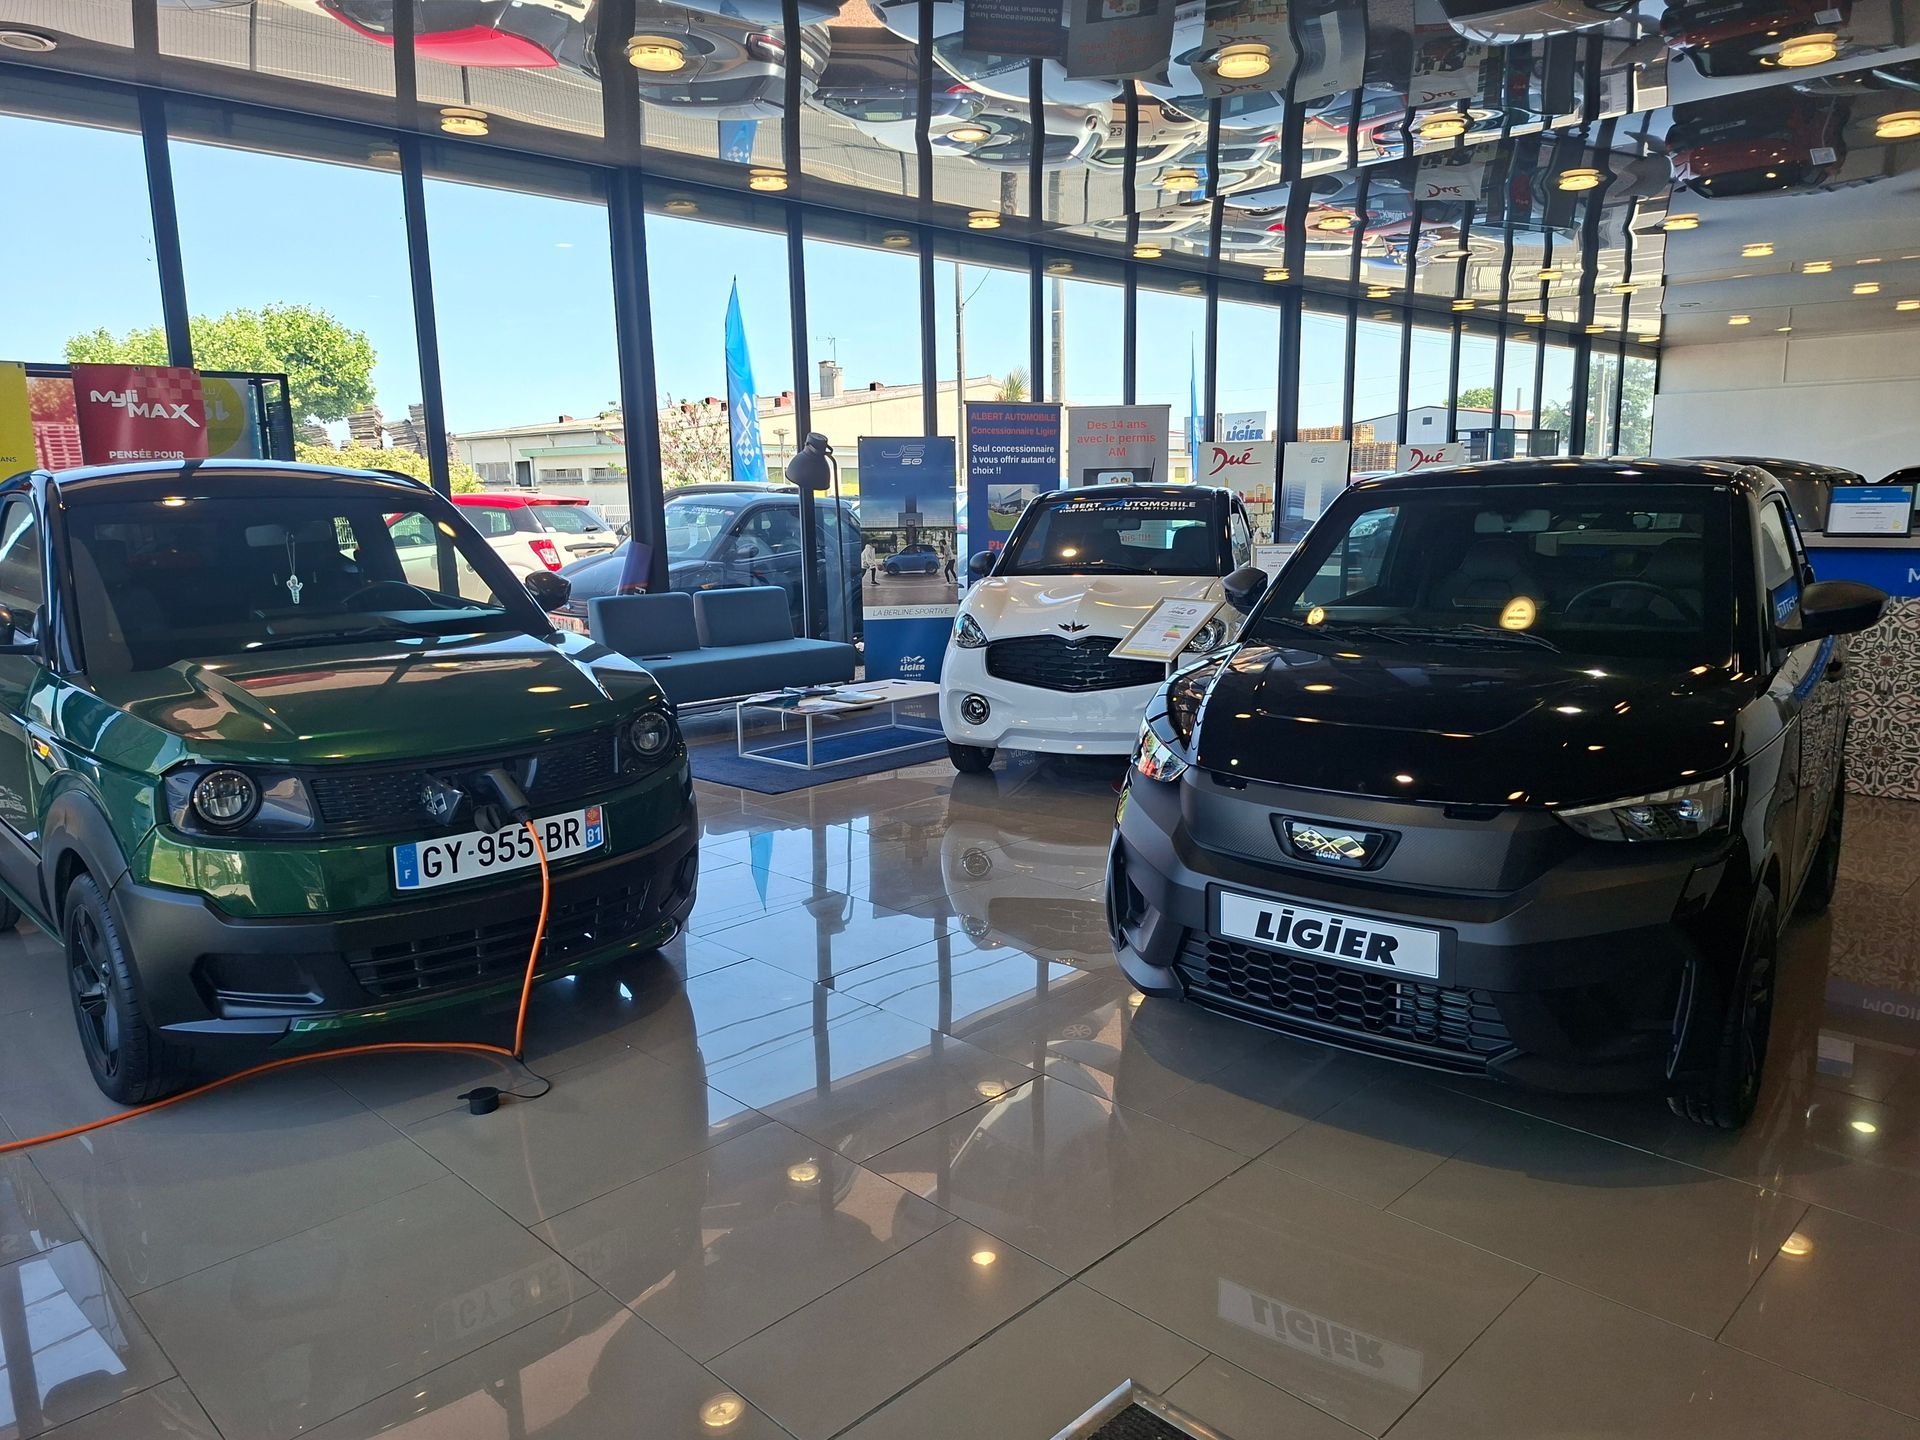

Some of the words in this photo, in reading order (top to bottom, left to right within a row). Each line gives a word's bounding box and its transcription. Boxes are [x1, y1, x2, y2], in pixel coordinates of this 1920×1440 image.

[128, 403, 200, 428] MAX
[971, 412, 1003, 421] ALBERT
[1004, 413, 1056, 422] AUTOMOBILE
[1111, 420, 1124, 430] 14
[1127, 421, 1148, 430] ans
[971, 426, 1034, 435] Concessionnaire
[1036, 427, 1056, 437] Ligier
[1077, 435, 1103, 444] avec
[1106, 433, 1115, 443] le
[1118, 433, 1157, 445] permis
[109, 448, 152, 460] PENSÉE
[154, 450, 184, 460] POUR
[972, 444, 990, 453] Seul
[991, 444, 1055, 453] concessionnaire
[1108, 447, 1126, 457] AM
[972, 454, 977, 464] à
[1000, 455, 1020, 464] offrir
[1021, 456, 1045, 464] autant
[1046, 455, 1056, 464] de
[1209, 447, 1262, 475] Dué
[1408, 448, 1453, 471] Dué
[972, 466, 994, 475] choix
[873, 609, 882, 617] LA
[883, 608, 914, 616] BERLINE
[915, 607, 949, 615] SPORTIVE
[587, 826, 601, 843] 81
[404, 869, 411, 880] F
